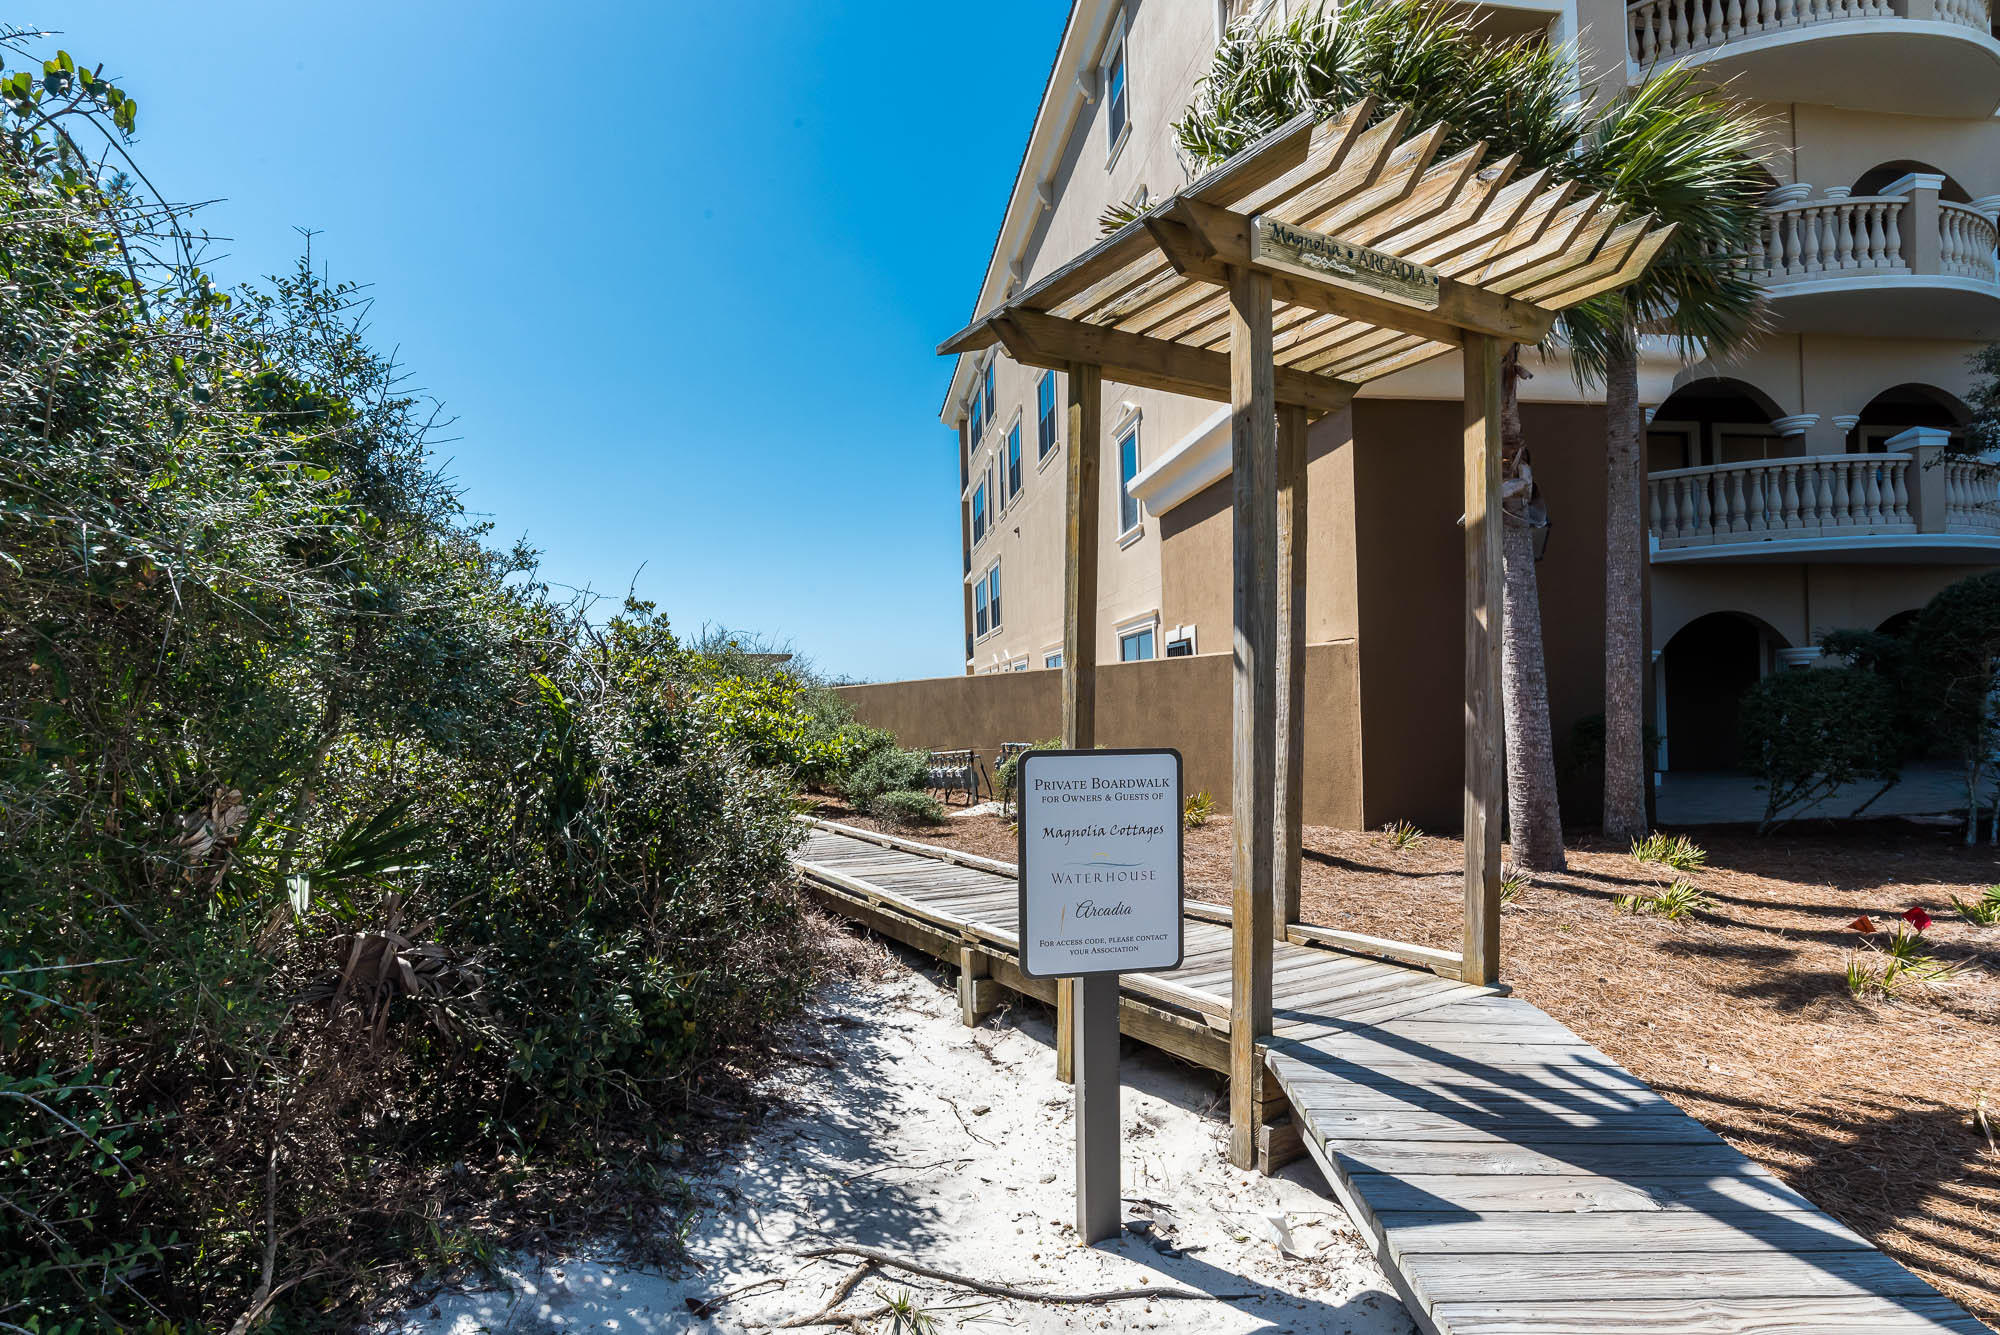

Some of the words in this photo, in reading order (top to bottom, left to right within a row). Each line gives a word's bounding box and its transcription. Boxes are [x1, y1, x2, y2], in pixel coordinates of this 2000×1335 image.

[1270, 223, 1342, 257] Magnolia
[1358, 249, 1427, 285] ARCADIA
[1034, 778, 1088, 791] PRIVATE
[1091, 777, 1170, 790] BOARDWALK
[1041, 795, 1060, 804] FOR
[1062, 793, 1103, 803] OWNERS
[1114, 792, 1150, 801] GUESTS
[1151, 792, 1164, 801] OF
[1042, 824, 1106, 847] Magnolia
[1109, 823, 1165, 844] Cottages
[1051, 870, 1157, 885] WATERHOUSE
[1075, 899, 1133, 919] Arcadia
[1039, 939, 1055, 948] FOR
[1056, 939, 1083, 947] ACCESS
[1108, 935, 1134, 943] PLEASE
[1135, 933, 1169, 942] CONTACT
[1069, 948, 1089, 956] YOUR
[1090, 945, 1139, 955] ASSOCIATION
